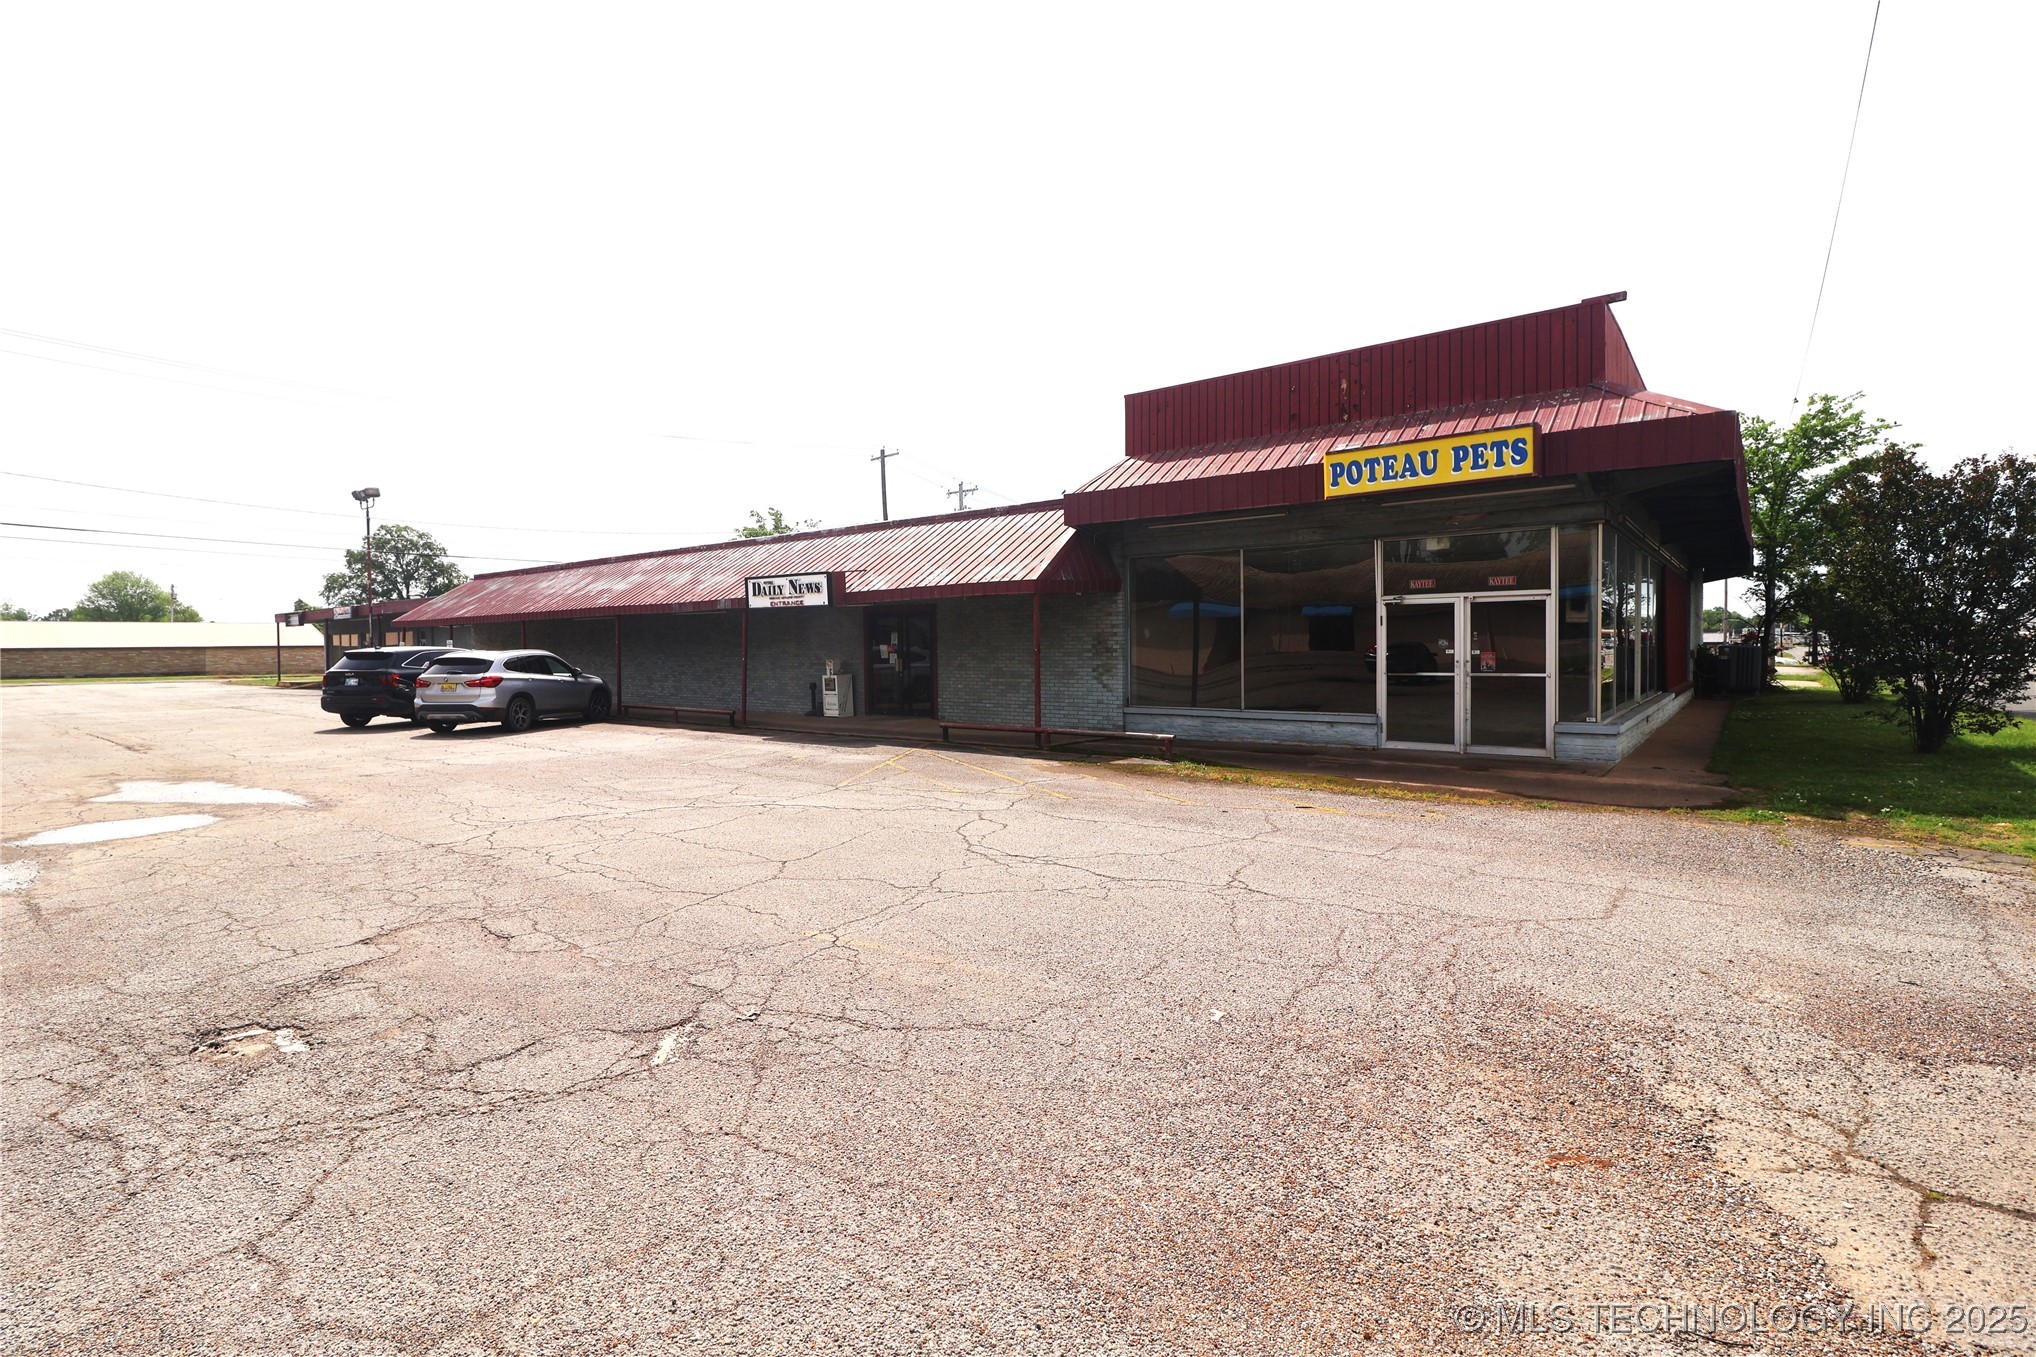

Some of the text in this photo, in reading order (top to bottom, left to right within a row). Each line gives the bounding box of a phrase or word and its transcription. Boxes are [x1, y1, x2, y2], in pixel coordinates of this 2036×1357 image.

[1330, 437, 1528, 488] POTEAU PETS
[752, 579, 822, 596] DAILY NEWS
